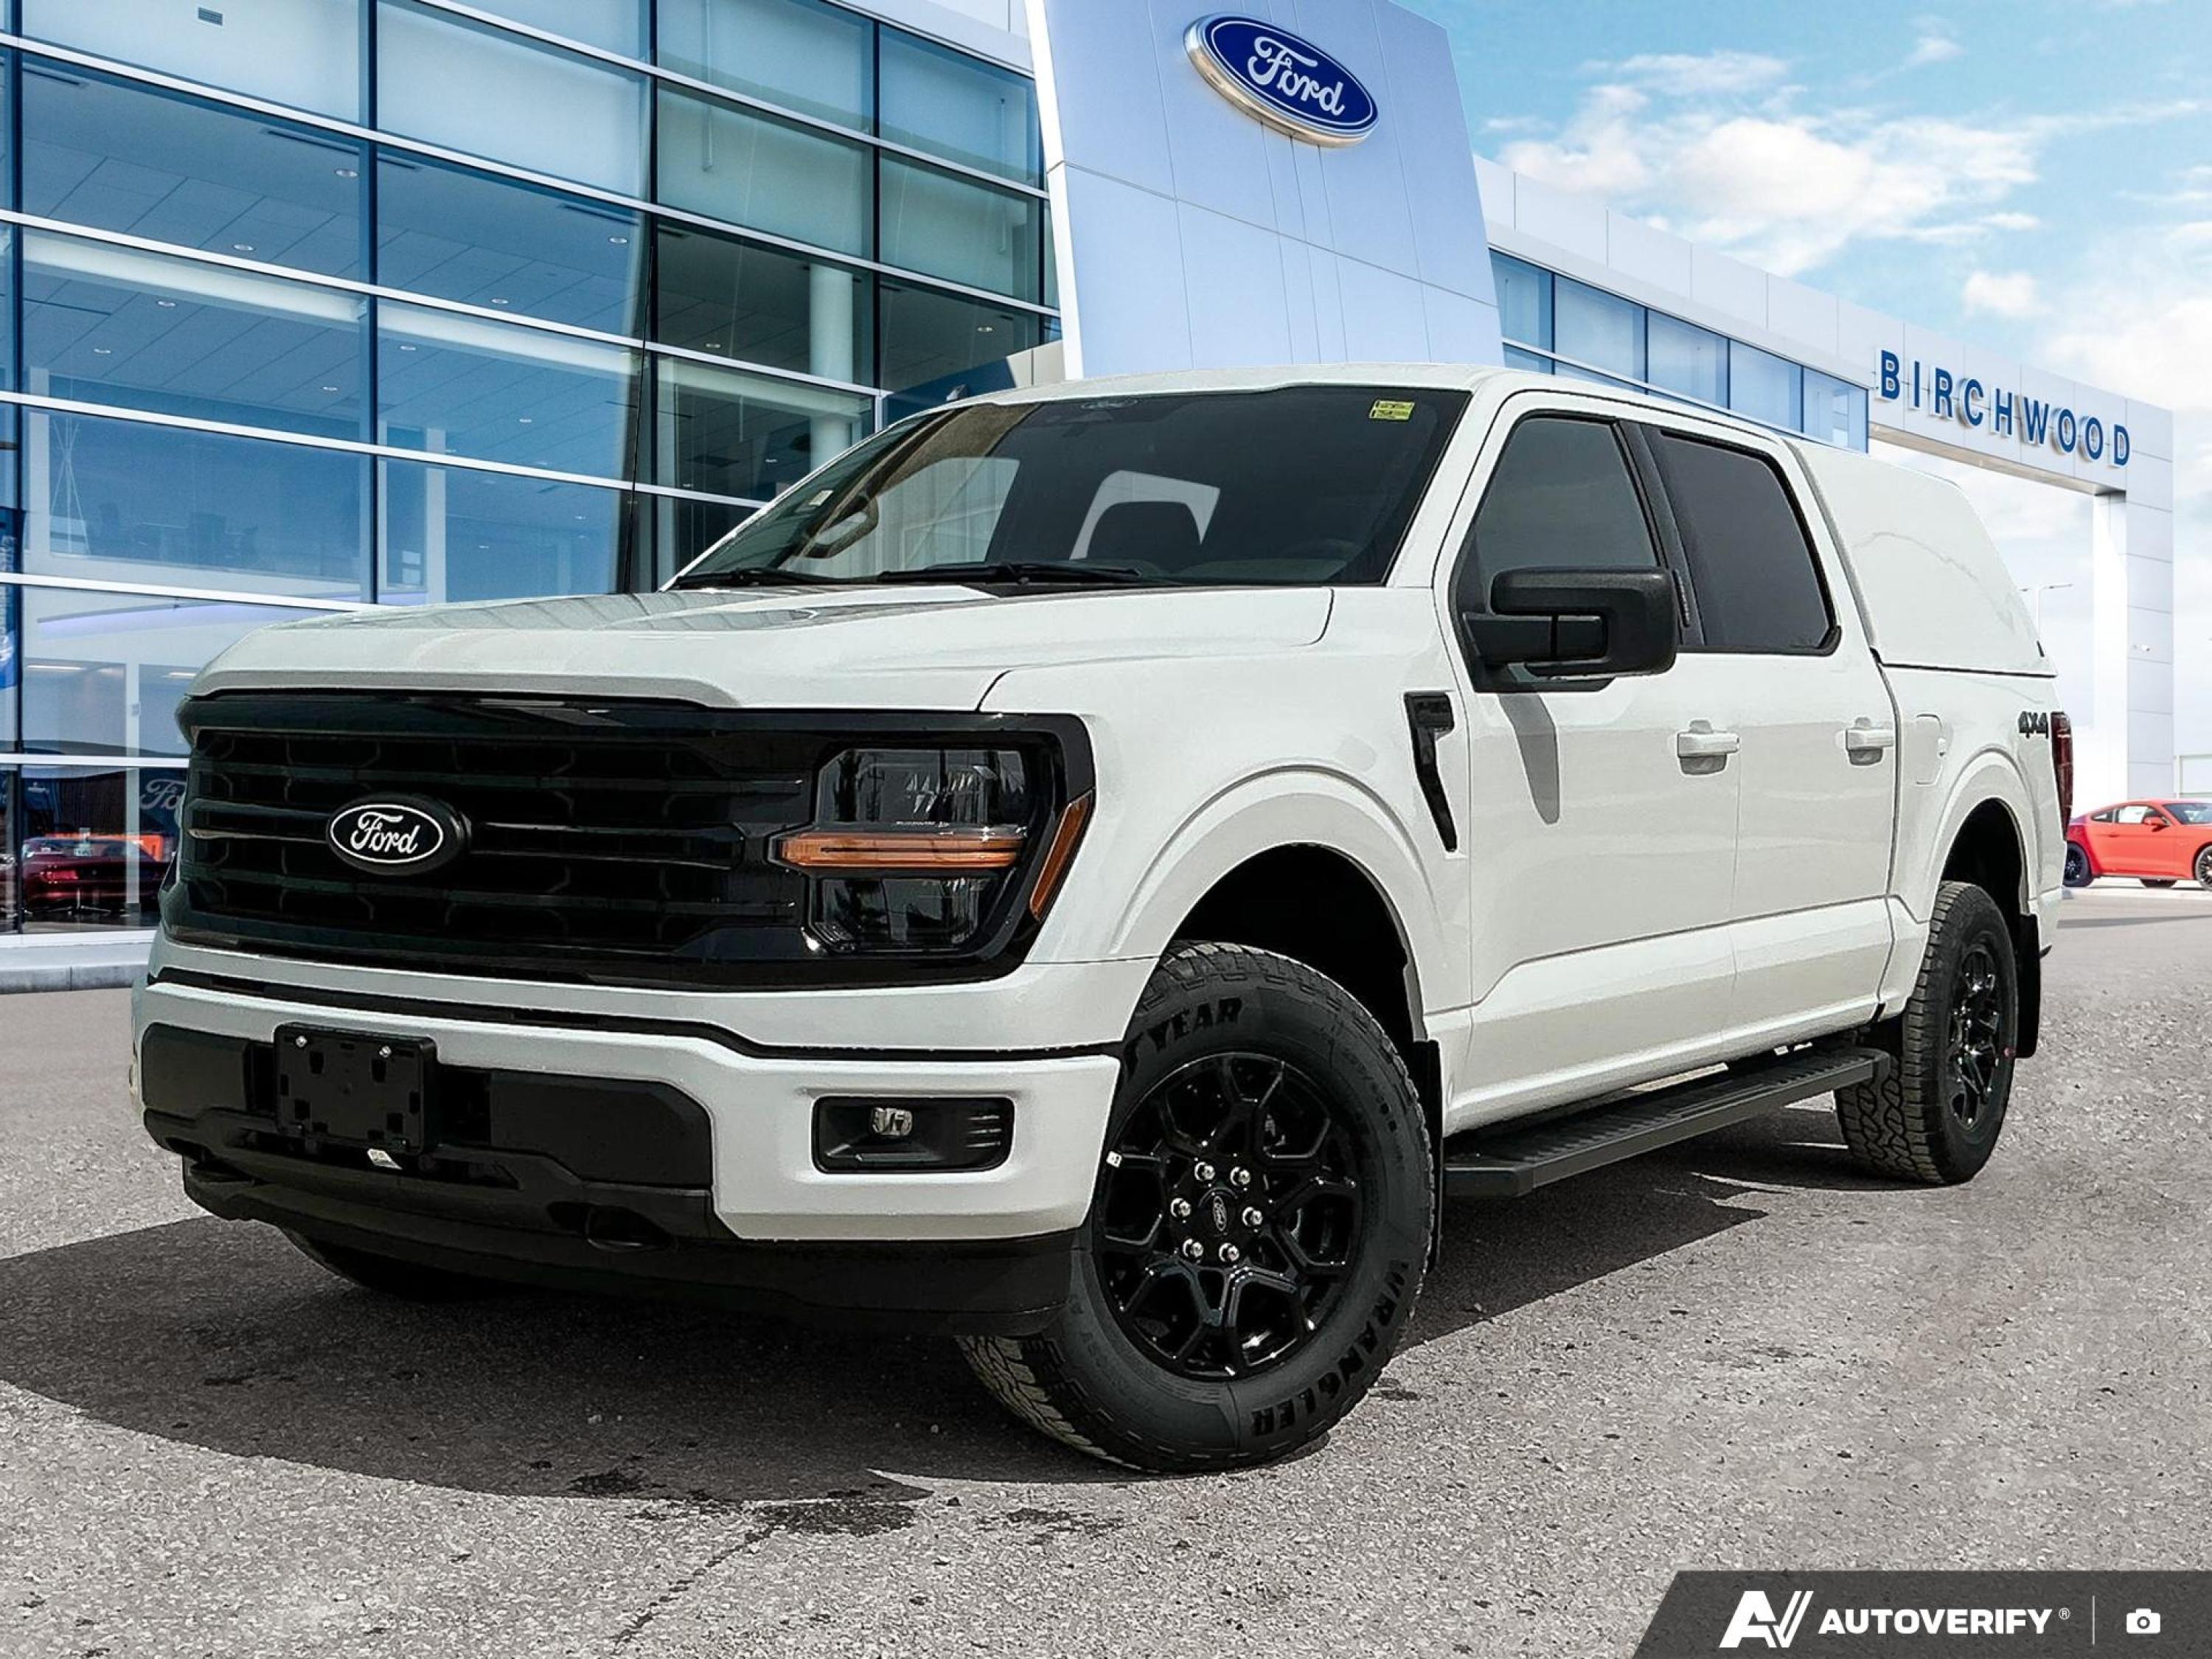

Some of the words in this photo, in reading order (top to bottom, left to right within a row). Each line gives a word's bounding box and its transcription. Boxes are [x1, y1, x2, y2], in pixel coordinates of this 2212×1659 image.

[1247, 36, 1346, 116] Ford
[1879, 349, 2131, 467] BIRCHWOOD
[140, 778, 187, 810] Fo
[350, 811, 421, 854] Ford
